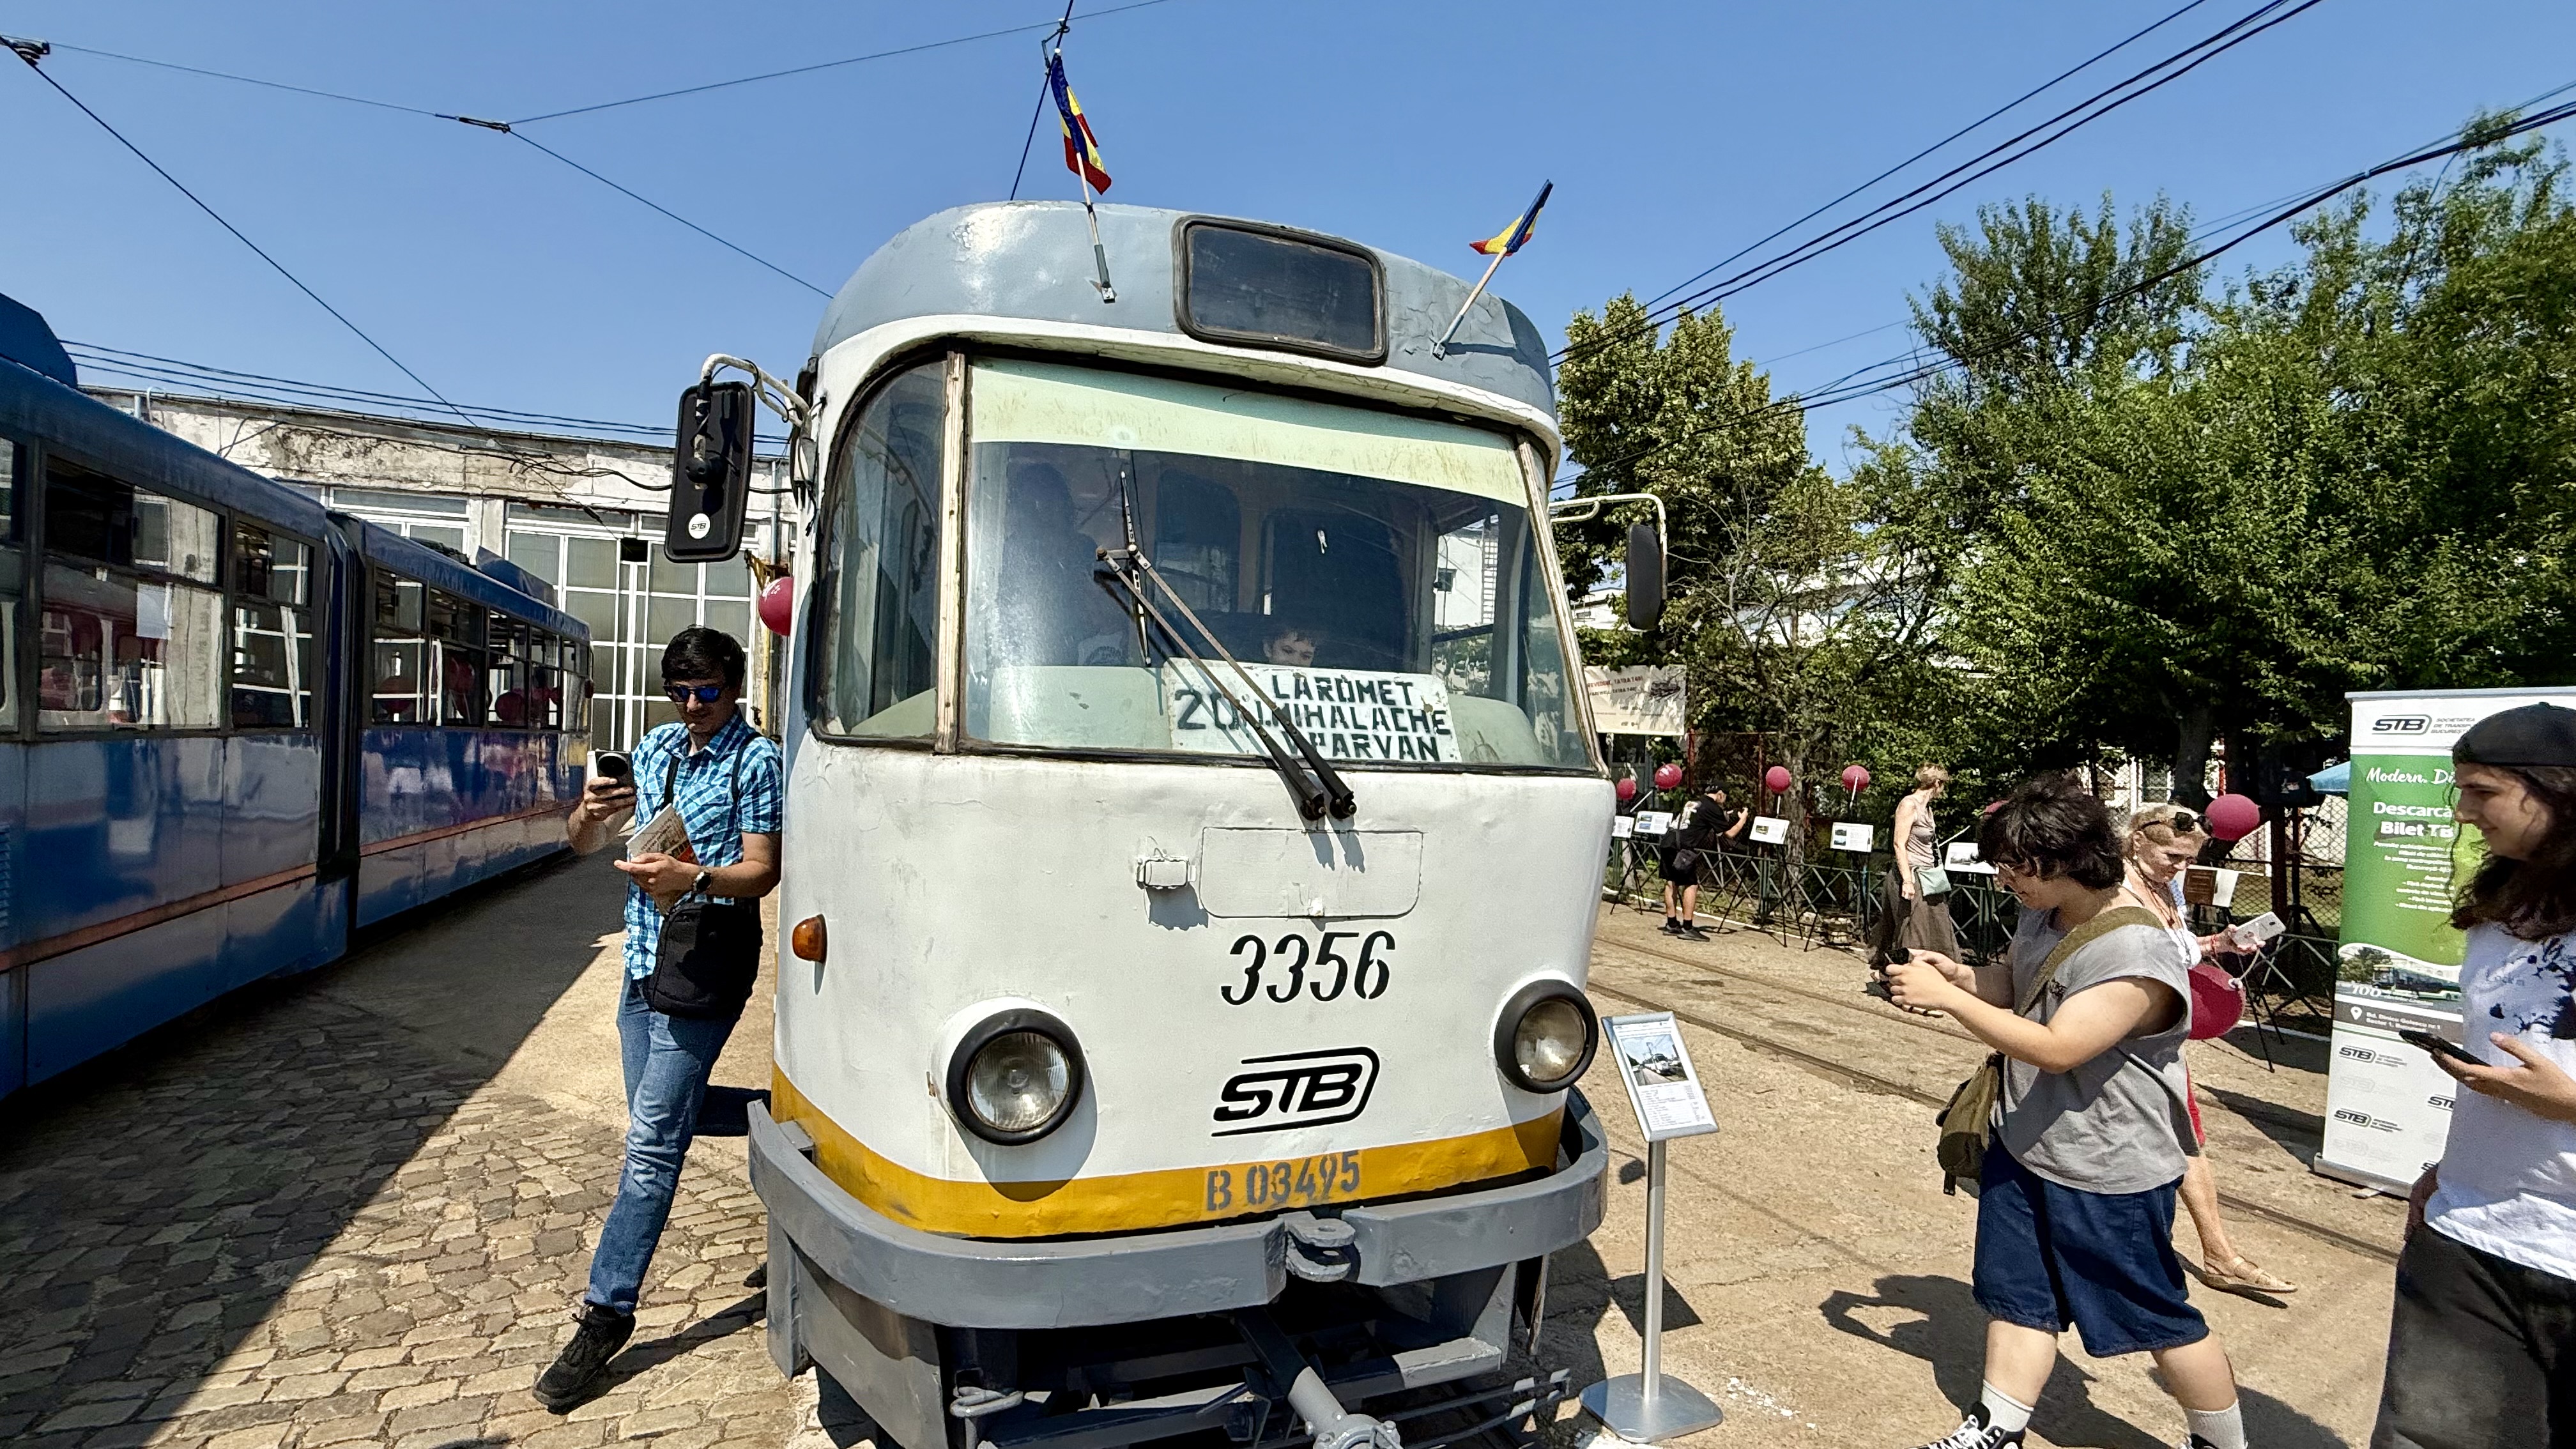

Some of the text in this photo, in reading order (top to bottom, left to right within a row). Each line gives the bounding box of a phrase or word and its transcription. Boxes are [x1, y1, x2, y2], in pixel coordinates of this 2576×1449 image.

[1272, 674, 1414, 706] LAROMET
[1175, 689, 1239, 730] 20
[2372, 718, 2426, 731] STB
[2366, 767, 2428, 783] Modern.
[2380, 821, 2425, 837] Bilet
[1221, 930, 1396, 1006] 3356
[2338, 1046, 2373, 1060] STB
[1213, 1063, 1363, 1122] STB
[2334, 1110, 2368, 1124] STB
[1208, 1150, 1360, 1211] B 03495
